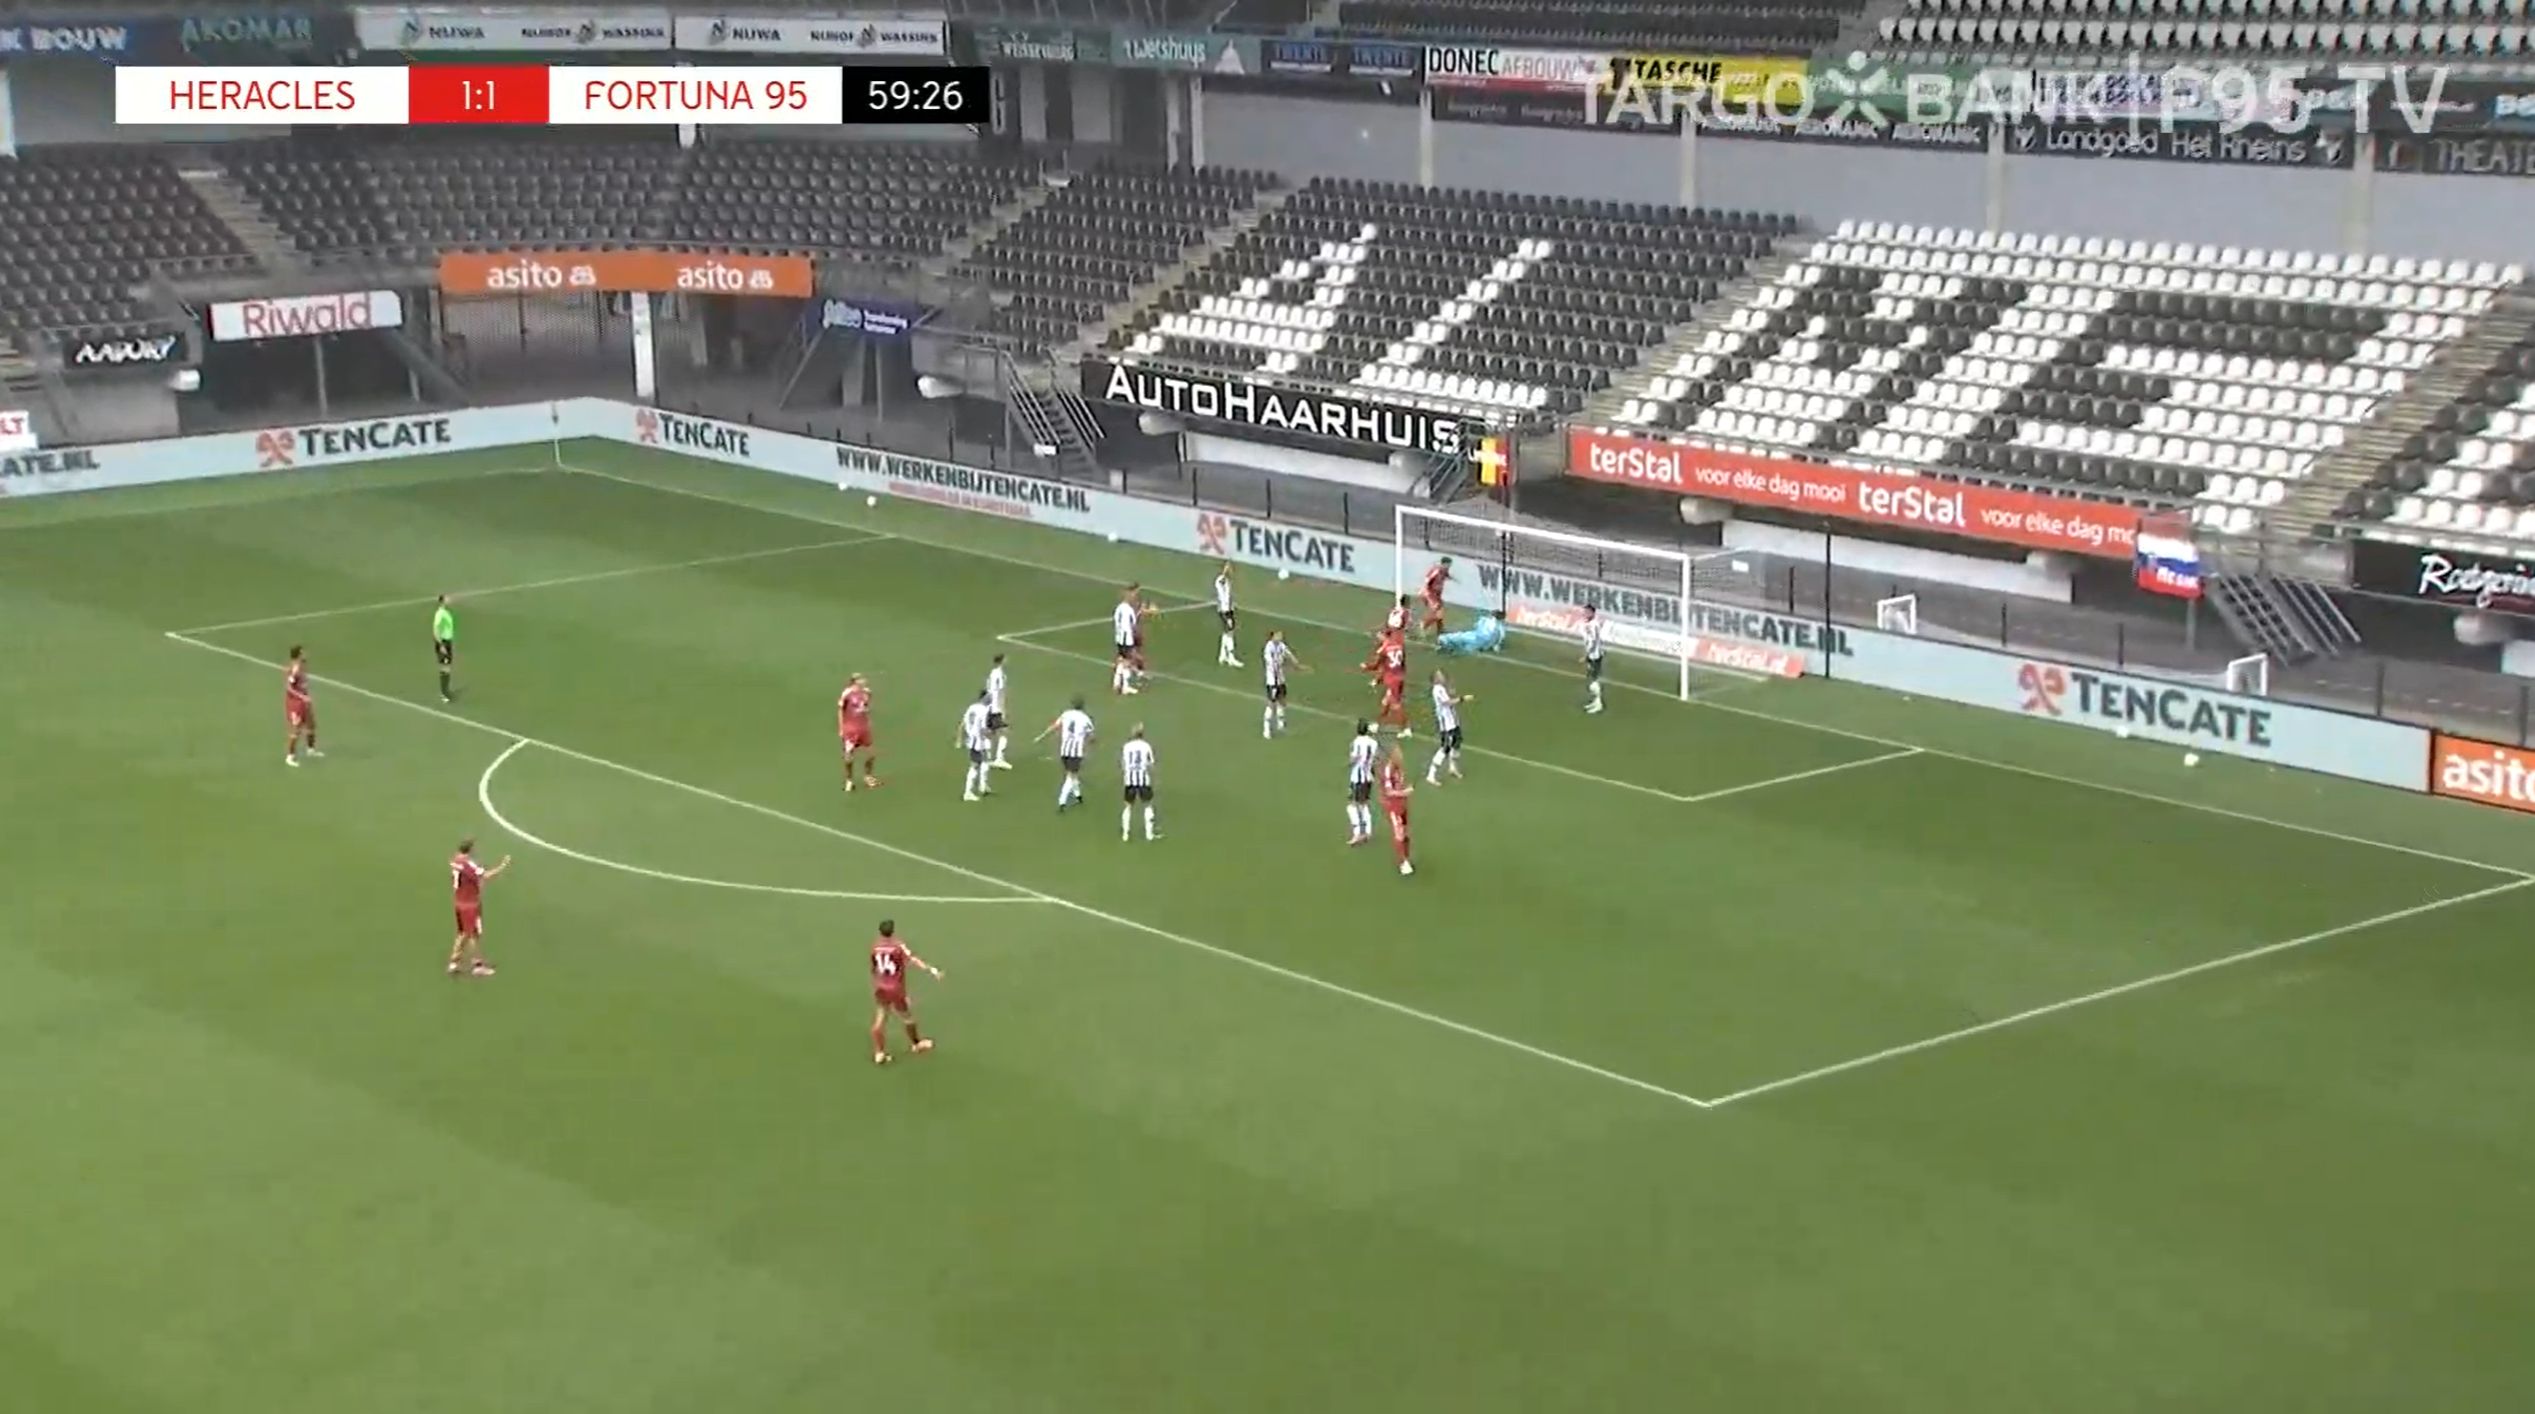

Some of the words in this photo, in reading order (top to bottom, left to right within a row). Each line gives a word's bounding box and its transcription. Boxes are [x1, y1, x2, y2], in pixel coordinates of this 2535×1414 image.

[30, 27, 127, 51] BOUW
[1429, 48, 1499, 75] DONEC
[2047, 128, 2159, 157] Landgoed
[486, 259, 562, 289] asito
[676, 262, 744, 291] asito
[242, 293, 373, 336] Riwald
[836, 446, 1091, 514] WWW.WERKENBIJTENCATE.NL
[1589, 442, 1684, 485] terStal
[1695, 467, 1731, 485] voor
[1732, 469, 1767, 492] elke
[1768, 472, 1800, 502] dag
[1803, 481, 1847, 502] mooi
[1858, 479, 1966, 529] terStal
[1980, 508, 2023, 529] voor
[2025, 510, 2064, 536] elke
[2066, 514, 2104, 547] dag
[874, 952, 897, 976] 14
